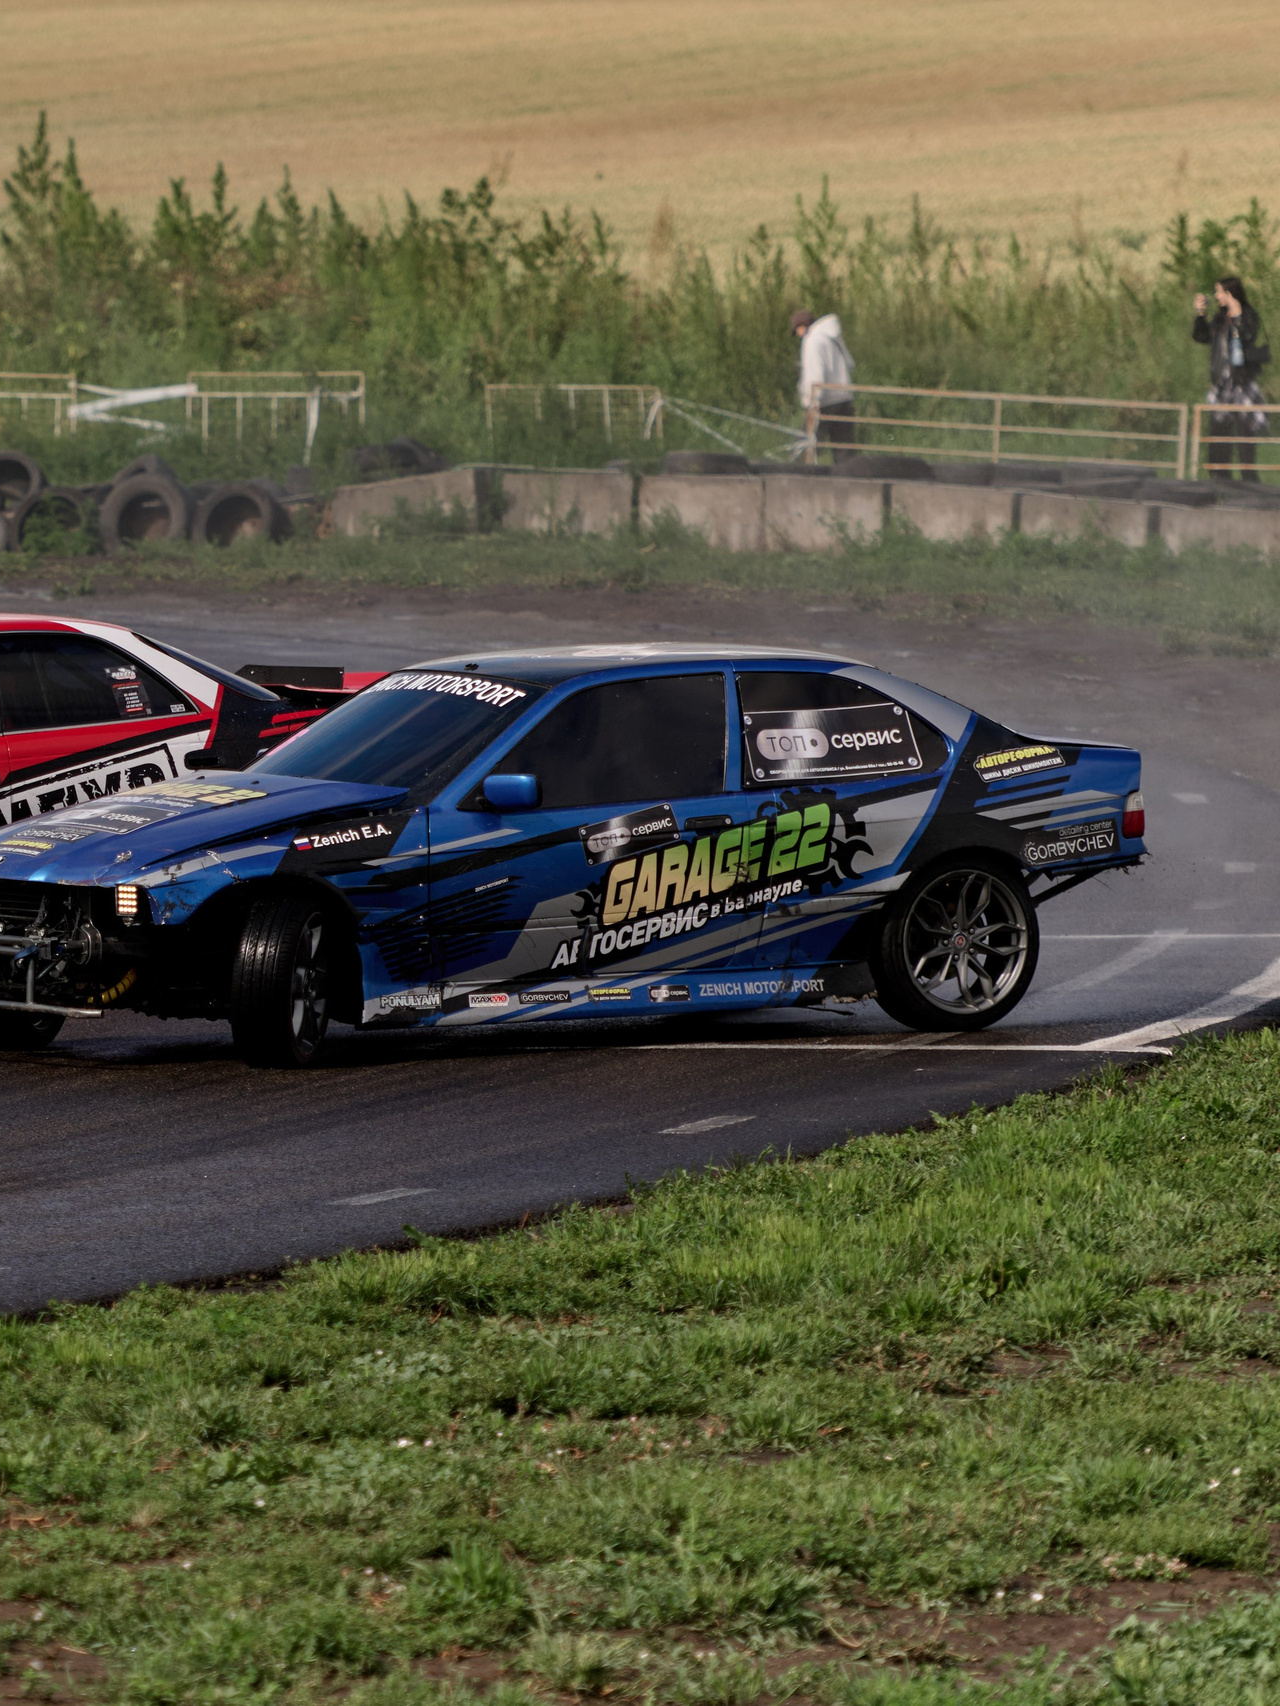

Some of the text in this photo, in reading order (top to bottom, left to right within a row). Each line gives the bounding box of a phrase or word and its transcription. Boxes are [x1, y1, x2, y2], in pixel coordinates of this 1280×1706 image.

[408, 674, 526, 707] MOTORSPORT
[766, 728, 903, 752] ТОП сервис
[310, 824, 392, 848] Zenich E.A.
[593, 817, 672, 848] ТОП сервис
[1090, 820, 1112, 832] center
[601, 803, 830, 926] GARAGE 22
[710, 903, 721, 918] в
[699, 978, 825, 997] ZENICH MOTOPORT
[381, 993, 440, 1008] PONULYAM
